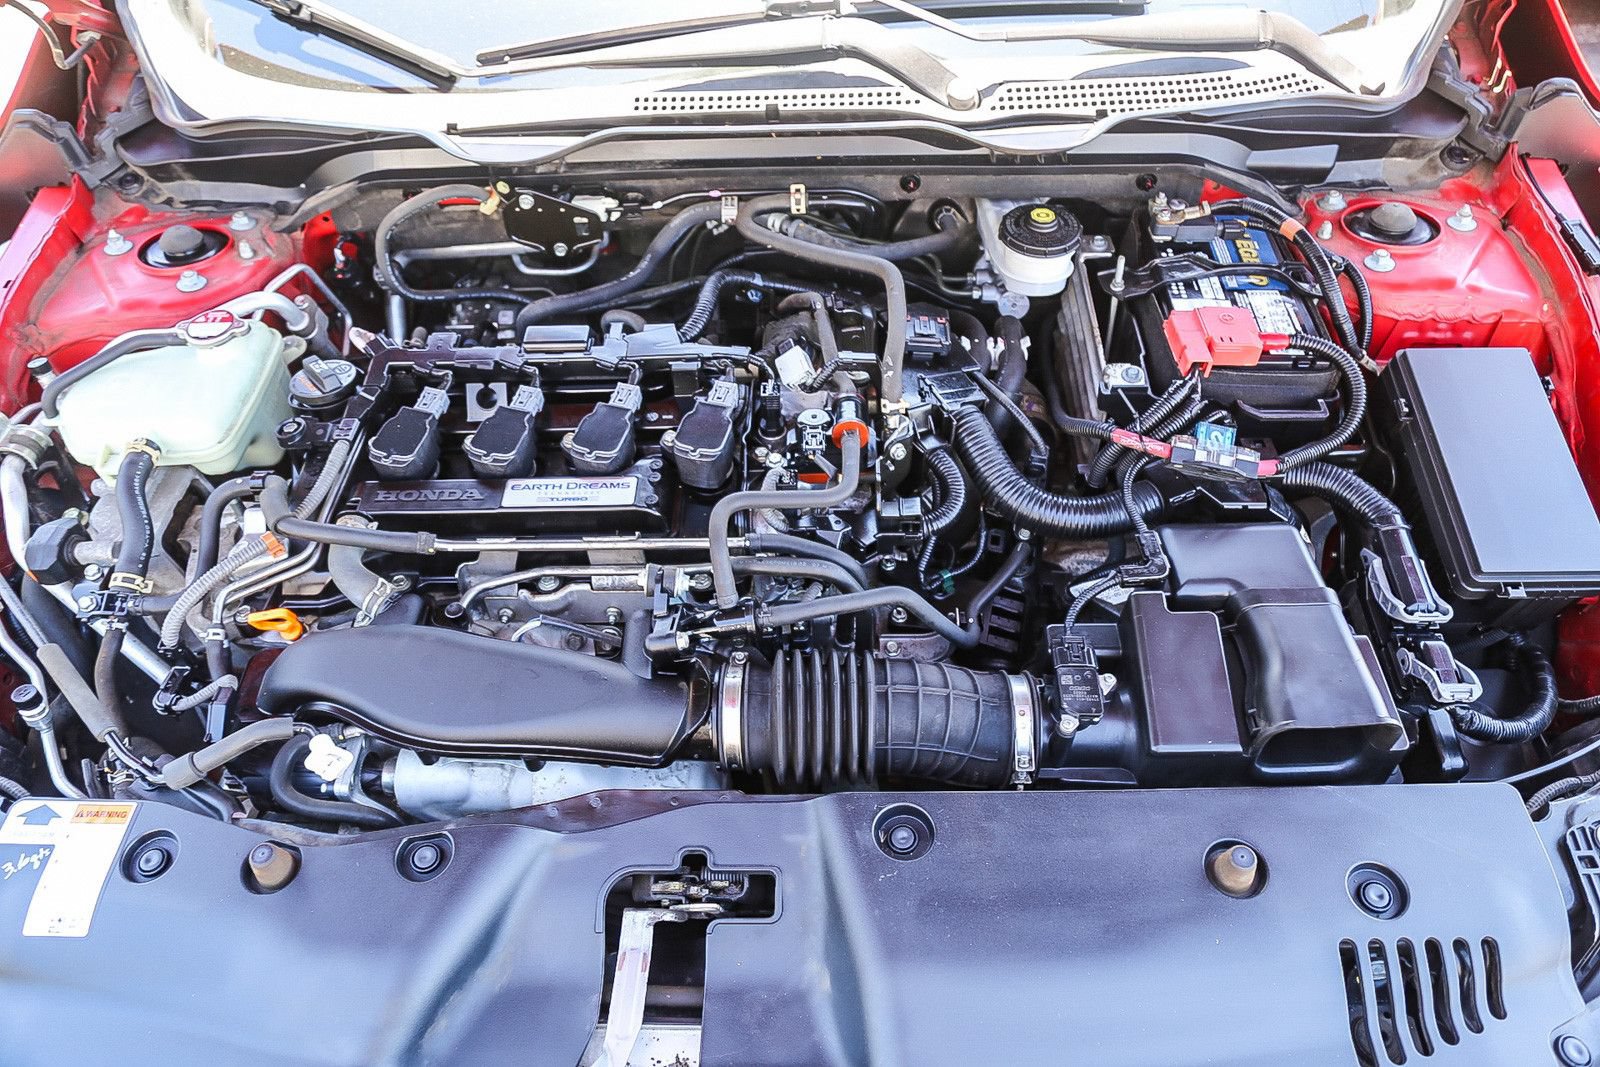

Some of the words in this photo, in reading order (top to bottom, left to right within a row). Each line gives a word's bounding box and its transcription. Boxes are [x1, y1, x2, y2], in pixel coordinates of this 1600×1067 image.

[510, 483, 563, 491] EARTH
[566, 482, 631, 491] DREAMS
[374, 488, 485, 501] HONDA
[85, 810, 128, 819] WARNING
